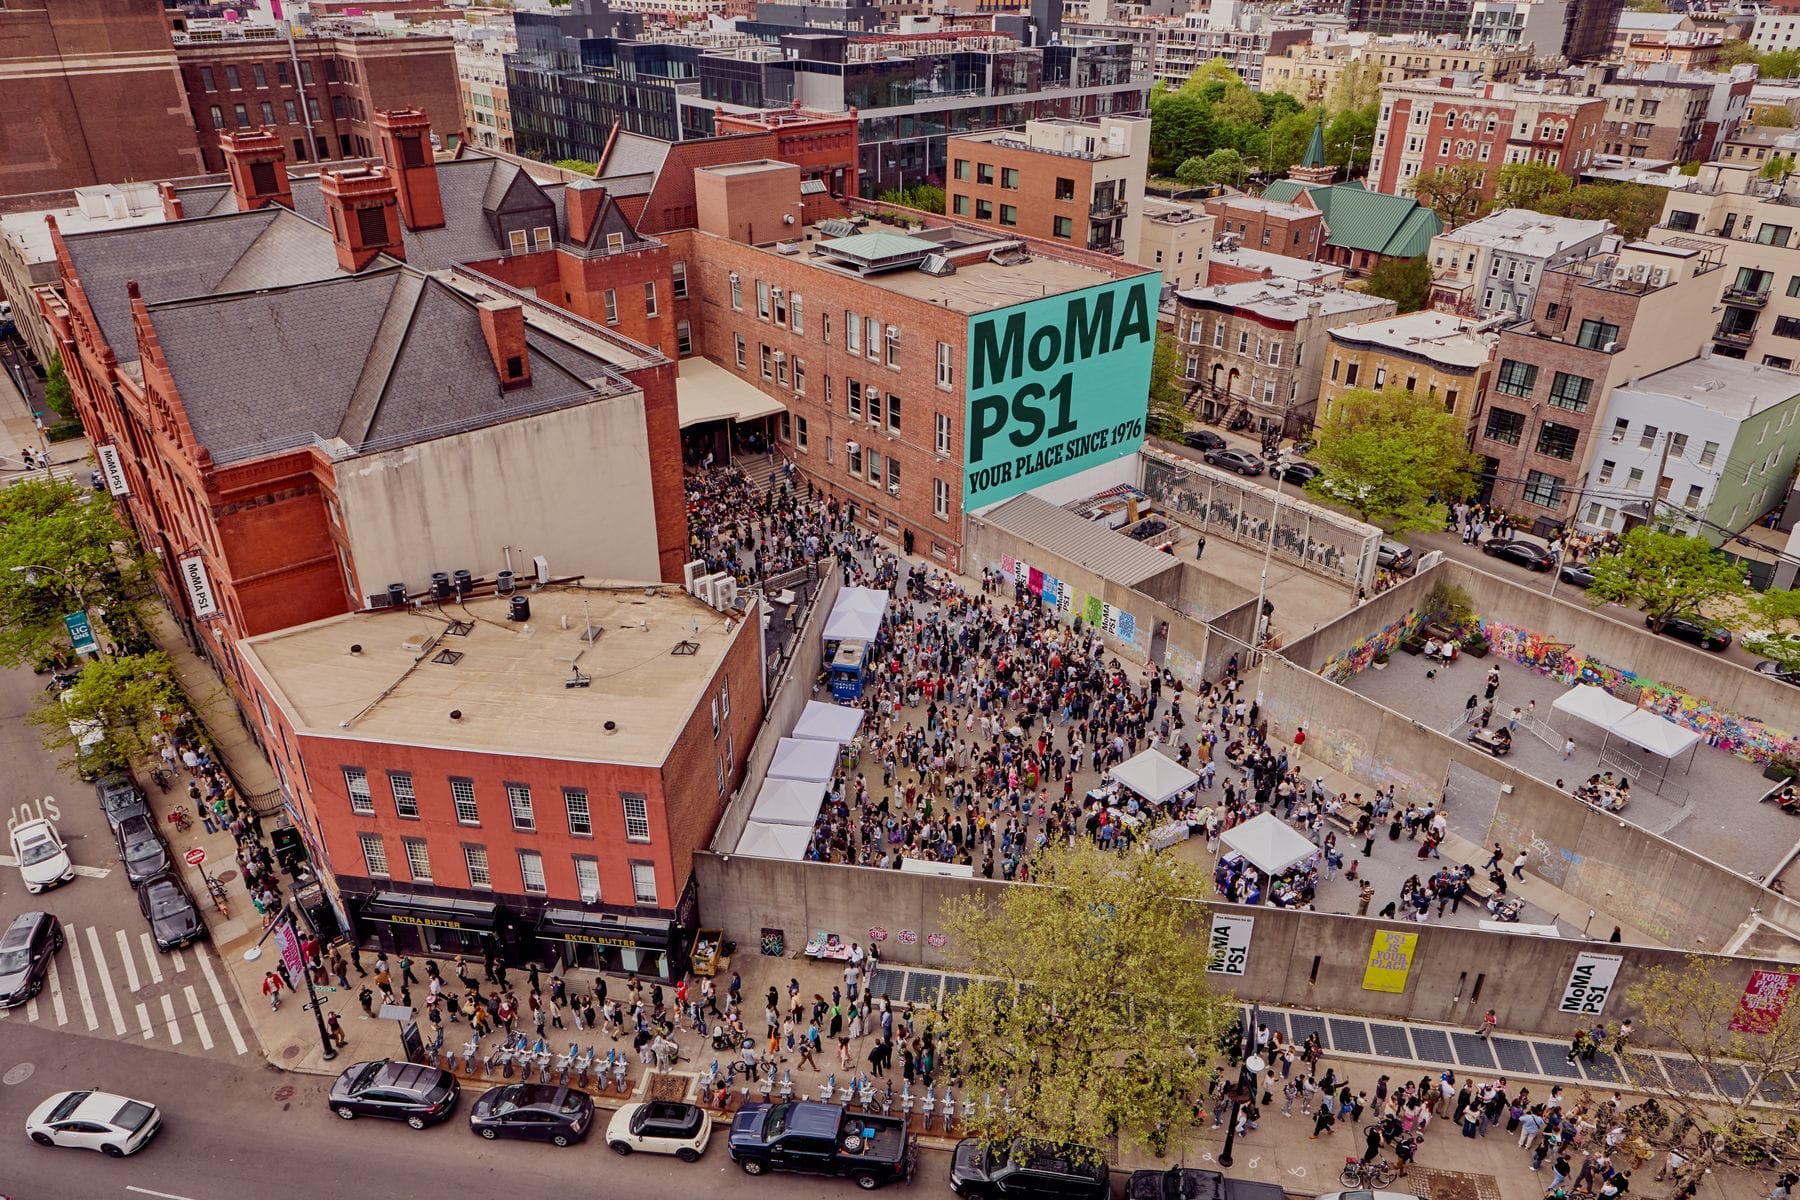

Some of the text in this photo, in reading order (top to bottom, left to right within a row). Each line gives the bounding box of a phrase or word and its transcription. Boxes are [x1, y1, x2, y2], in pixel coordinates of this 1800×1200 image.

[972, 283, 1151, 391] MoMA
[970, 372, 1078, 464] PS1
[969, 417, 1142, 494] YOUR PLACE SINCE 1976
[104, 450, 123, 491] MoMA PS1
[188, 563, 209, 611] MoMA PS1
[70, 625, 88, 636] LIC
[1102, 604, 1110, 631] MoMA
[391, 914, 461, 929] EXTRA BUTTER
[564, 933, 637, 947] EXTRA BUTTER
[1207, 925, 1231, 972] MoMA
[1386, 933, 1406, 945] PS1
[1388, 943, 1399, 952] IS
[1226, 946, 1247, 974] PS1
[1370, 959, 1408, 971] PLACE
[1377, 950, 1408, 962] YOUR
[1562, 964, 1596, 1011] MoMA
[1754, 980, 1788, 991] PLACE
[1762, 973, 1789, 984] YOUR
[1581, 985, 1609, 1013] PS1
